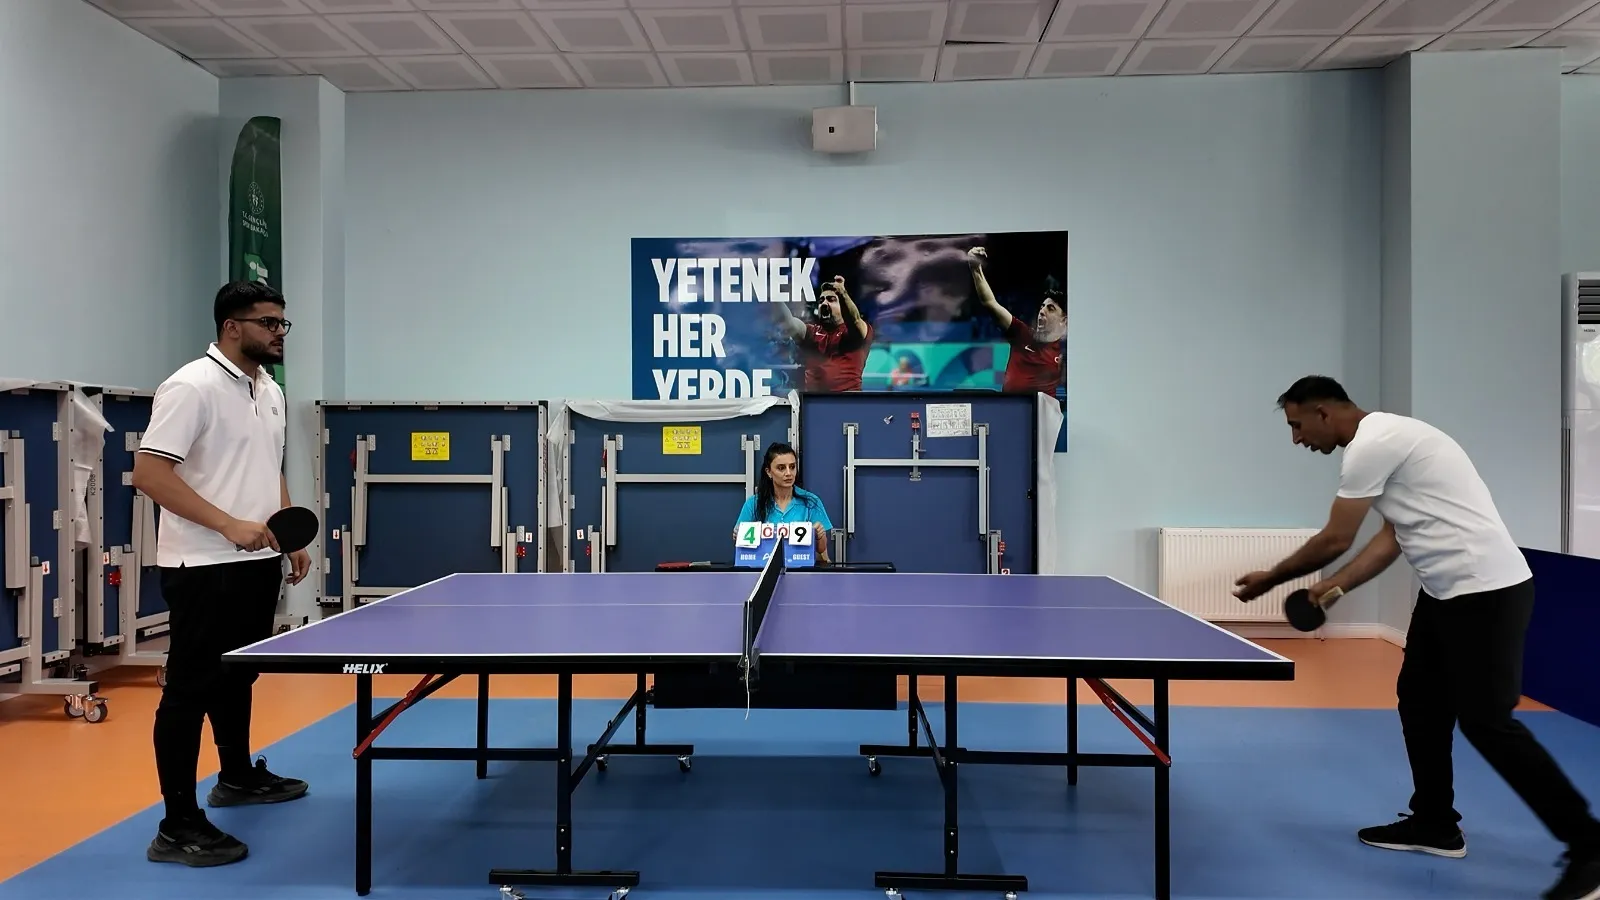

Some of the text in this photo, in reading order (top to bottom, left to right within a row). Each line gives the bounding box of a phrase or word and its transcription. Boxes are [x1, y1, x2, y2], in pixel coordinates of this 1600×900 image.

[651, 257, 817, 303] YETENEK
[652, 314, 726, 358] HER
[652, 369, 772, 400] YERDE
[743, 526, 756, 544] 4
[794, 526, 807, 543] 9
[740, 553, 757, 561] HOME
[792, 553, 810, 561] GUEST
[342, 663, 386, 674] HELIX
